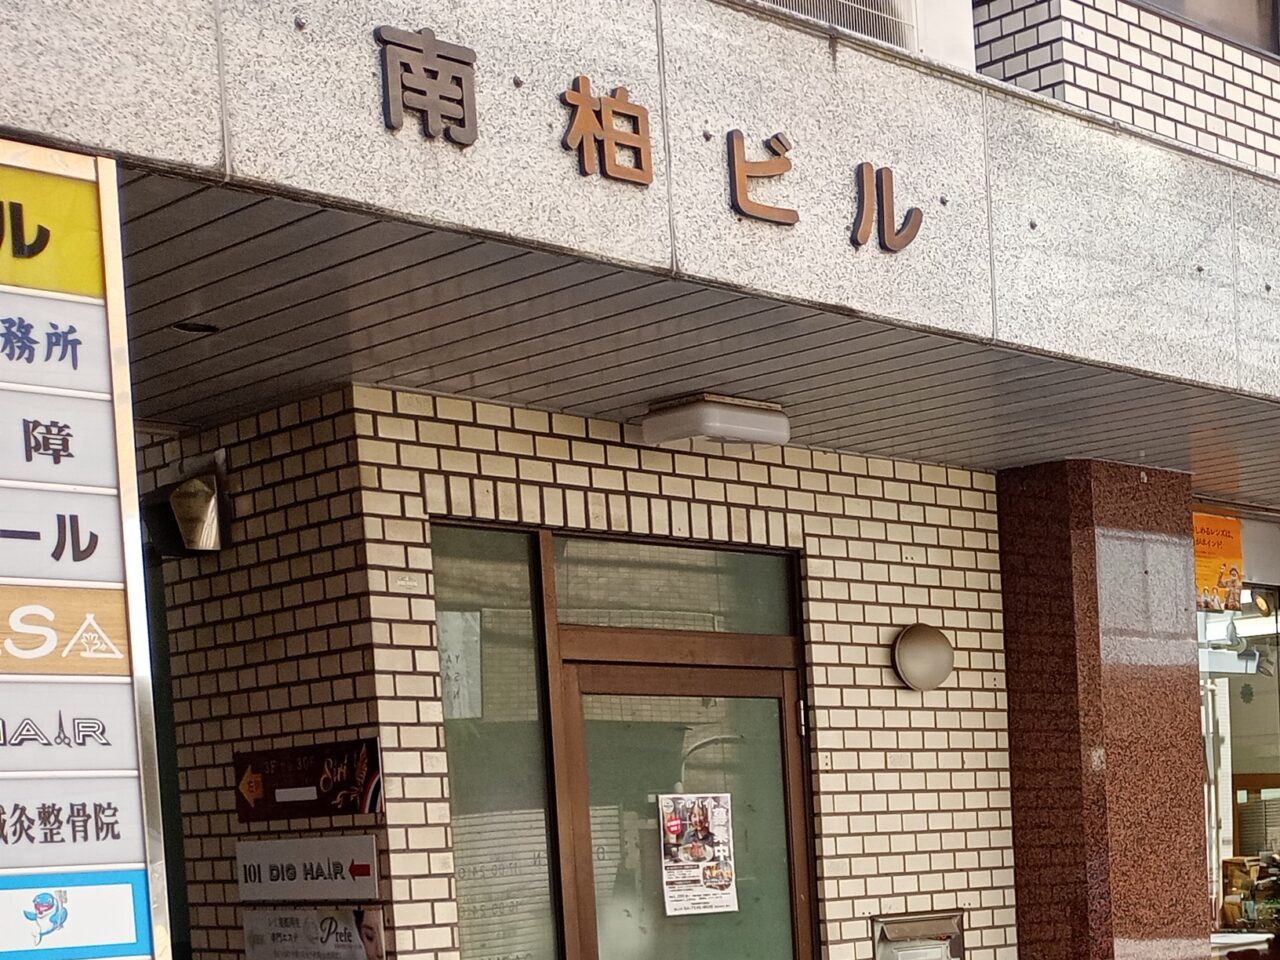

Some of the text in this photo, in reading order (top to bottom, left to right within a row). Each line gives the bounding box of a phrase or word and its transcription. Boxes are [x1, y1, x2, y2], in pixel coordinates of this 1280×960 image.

[374, 25, 923, 252] 南柏ビル
[23, 419, 75, 465] 障
[0, 709, 112, 748] AIR
